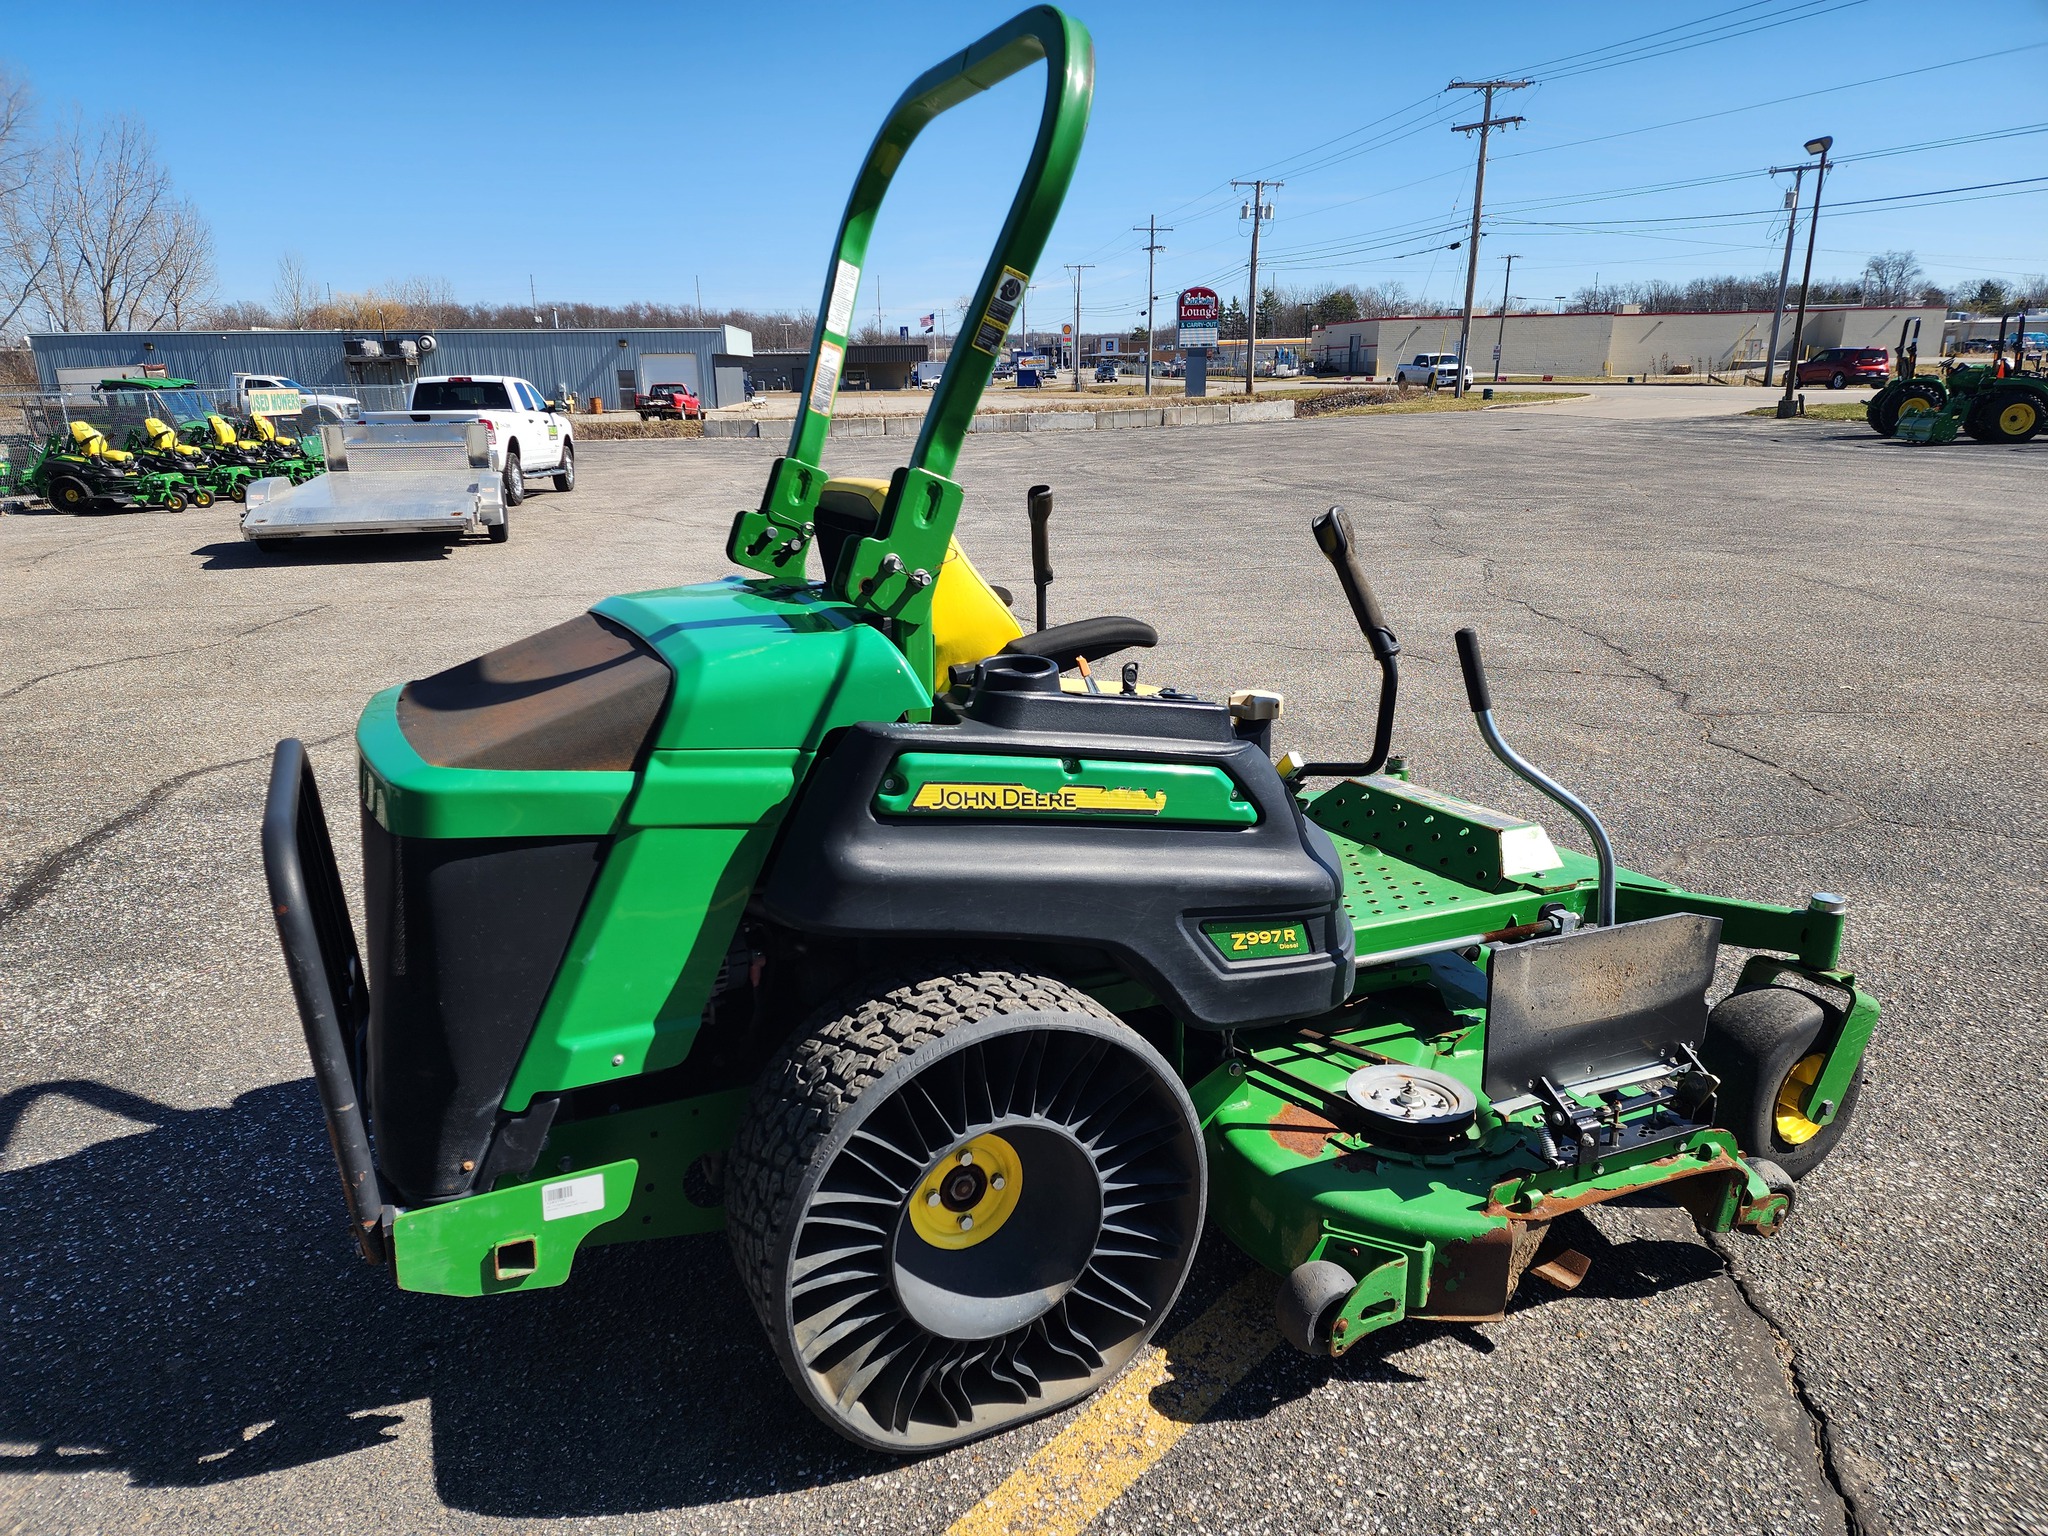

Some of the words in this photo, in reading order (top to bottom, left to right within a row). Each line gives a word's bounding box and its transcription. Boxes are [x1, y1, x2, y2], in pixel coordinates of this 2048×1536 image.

[1181, 306, 1217, 319] Lounge
[250, 393, 270, 412] USED
[271, 393, 300, 411] MOWERS
[933, 788, 997, 807] JOHN
[1003, 788, 1077, 808] DEERE
